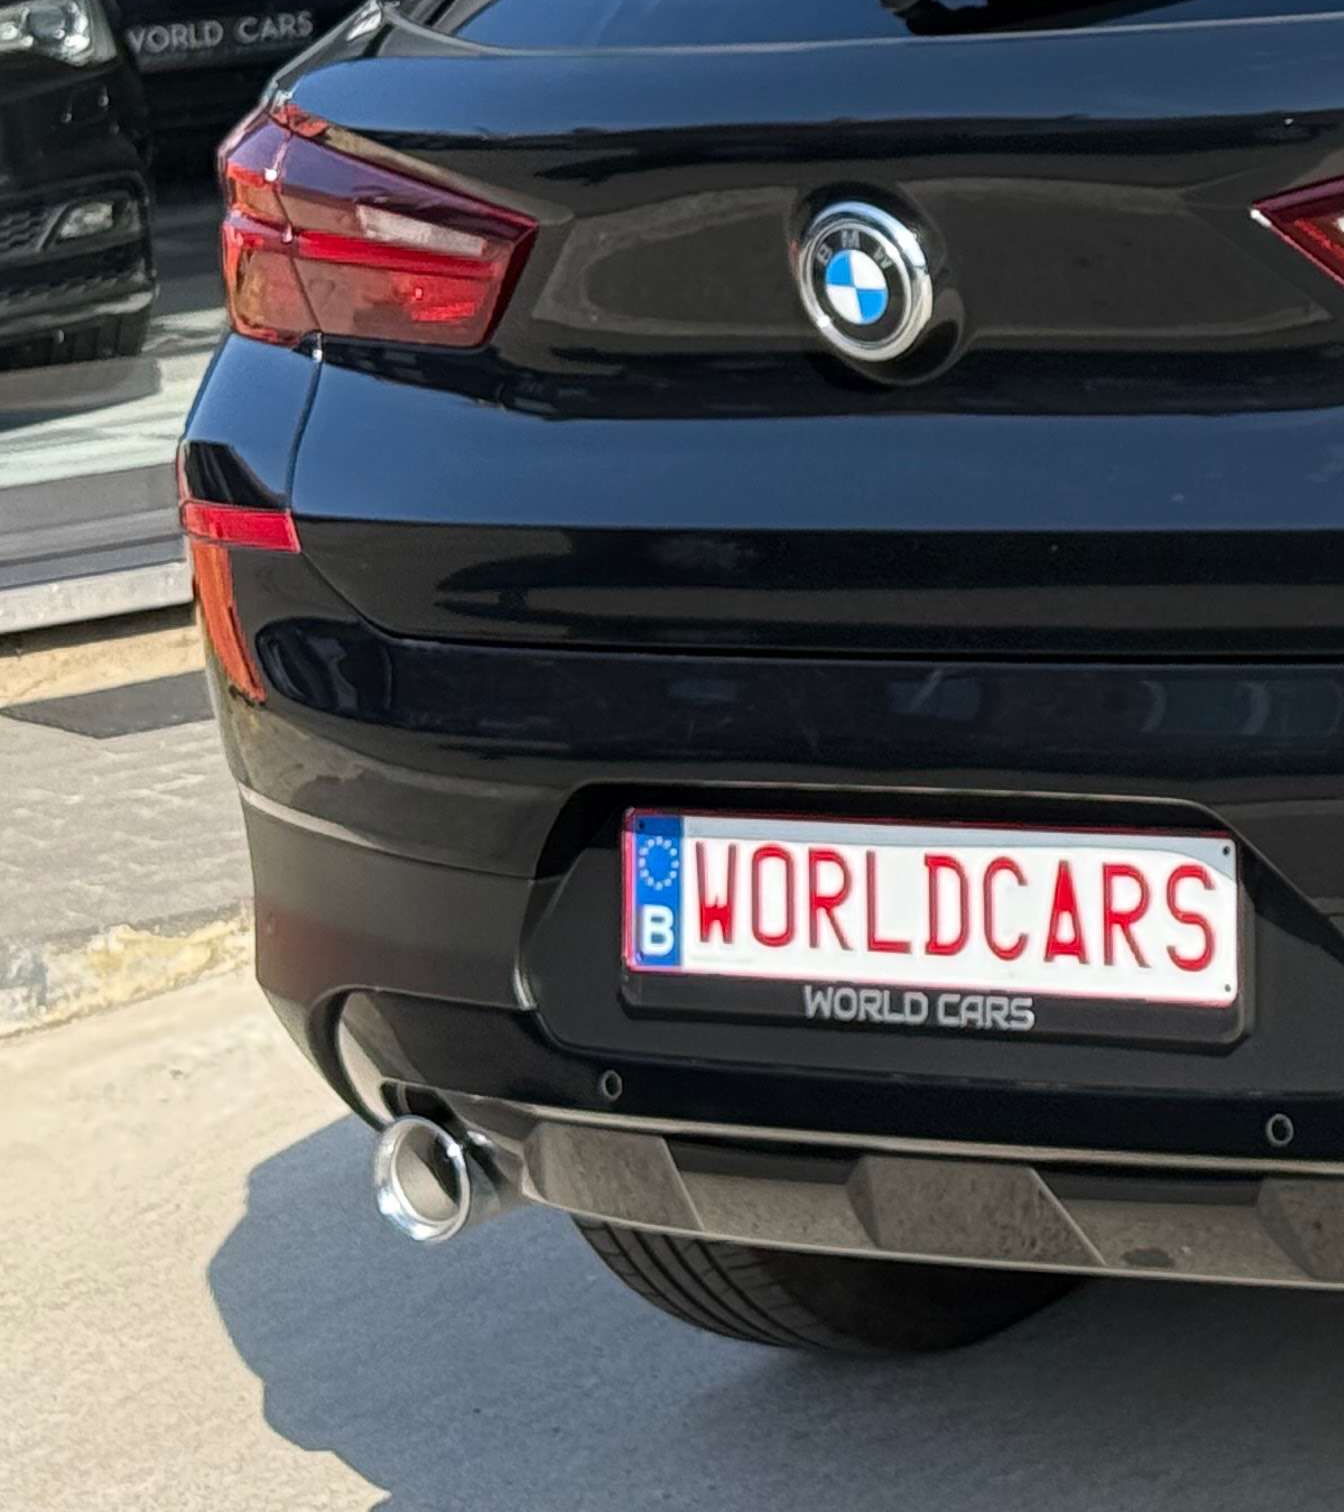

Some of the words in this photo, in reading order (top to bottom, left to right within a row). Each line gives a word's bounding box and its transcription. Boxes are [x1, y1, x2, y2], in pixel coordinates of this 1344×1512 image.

[238, 10, 315, 46] CARS
[640, 905, 675, 957] B
[694, 840, 1217, 973] WORLDCARS
[803, 984, 929, 1026] WORLD
[936, 993, 1036, 1031] CARS
